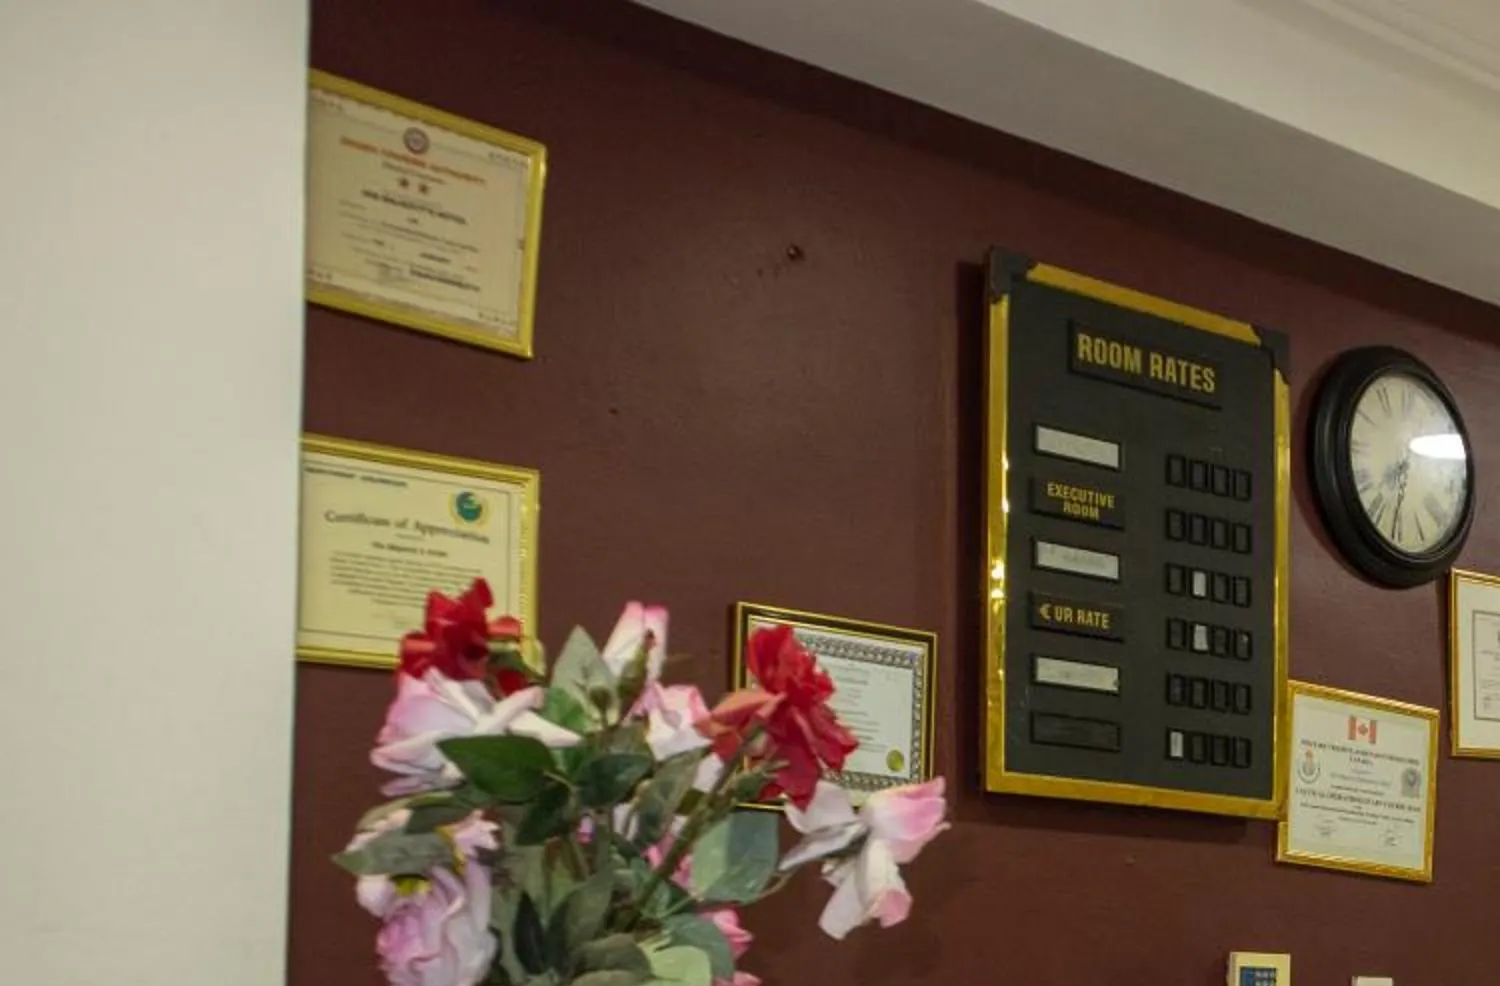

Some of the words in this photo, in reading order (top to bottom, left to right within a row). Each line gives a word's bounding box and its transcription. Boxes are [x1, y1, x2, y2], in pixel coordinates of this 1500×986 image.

[1076, 333, 1142, 375] ROOM
[1149, 351, 1216, 393] RATES
[1047, 482, 1115, 509] EXECUTIVE
[1063, 501, 1100, 521] ROOM
[1077, 608, 1111, 629] RATE
